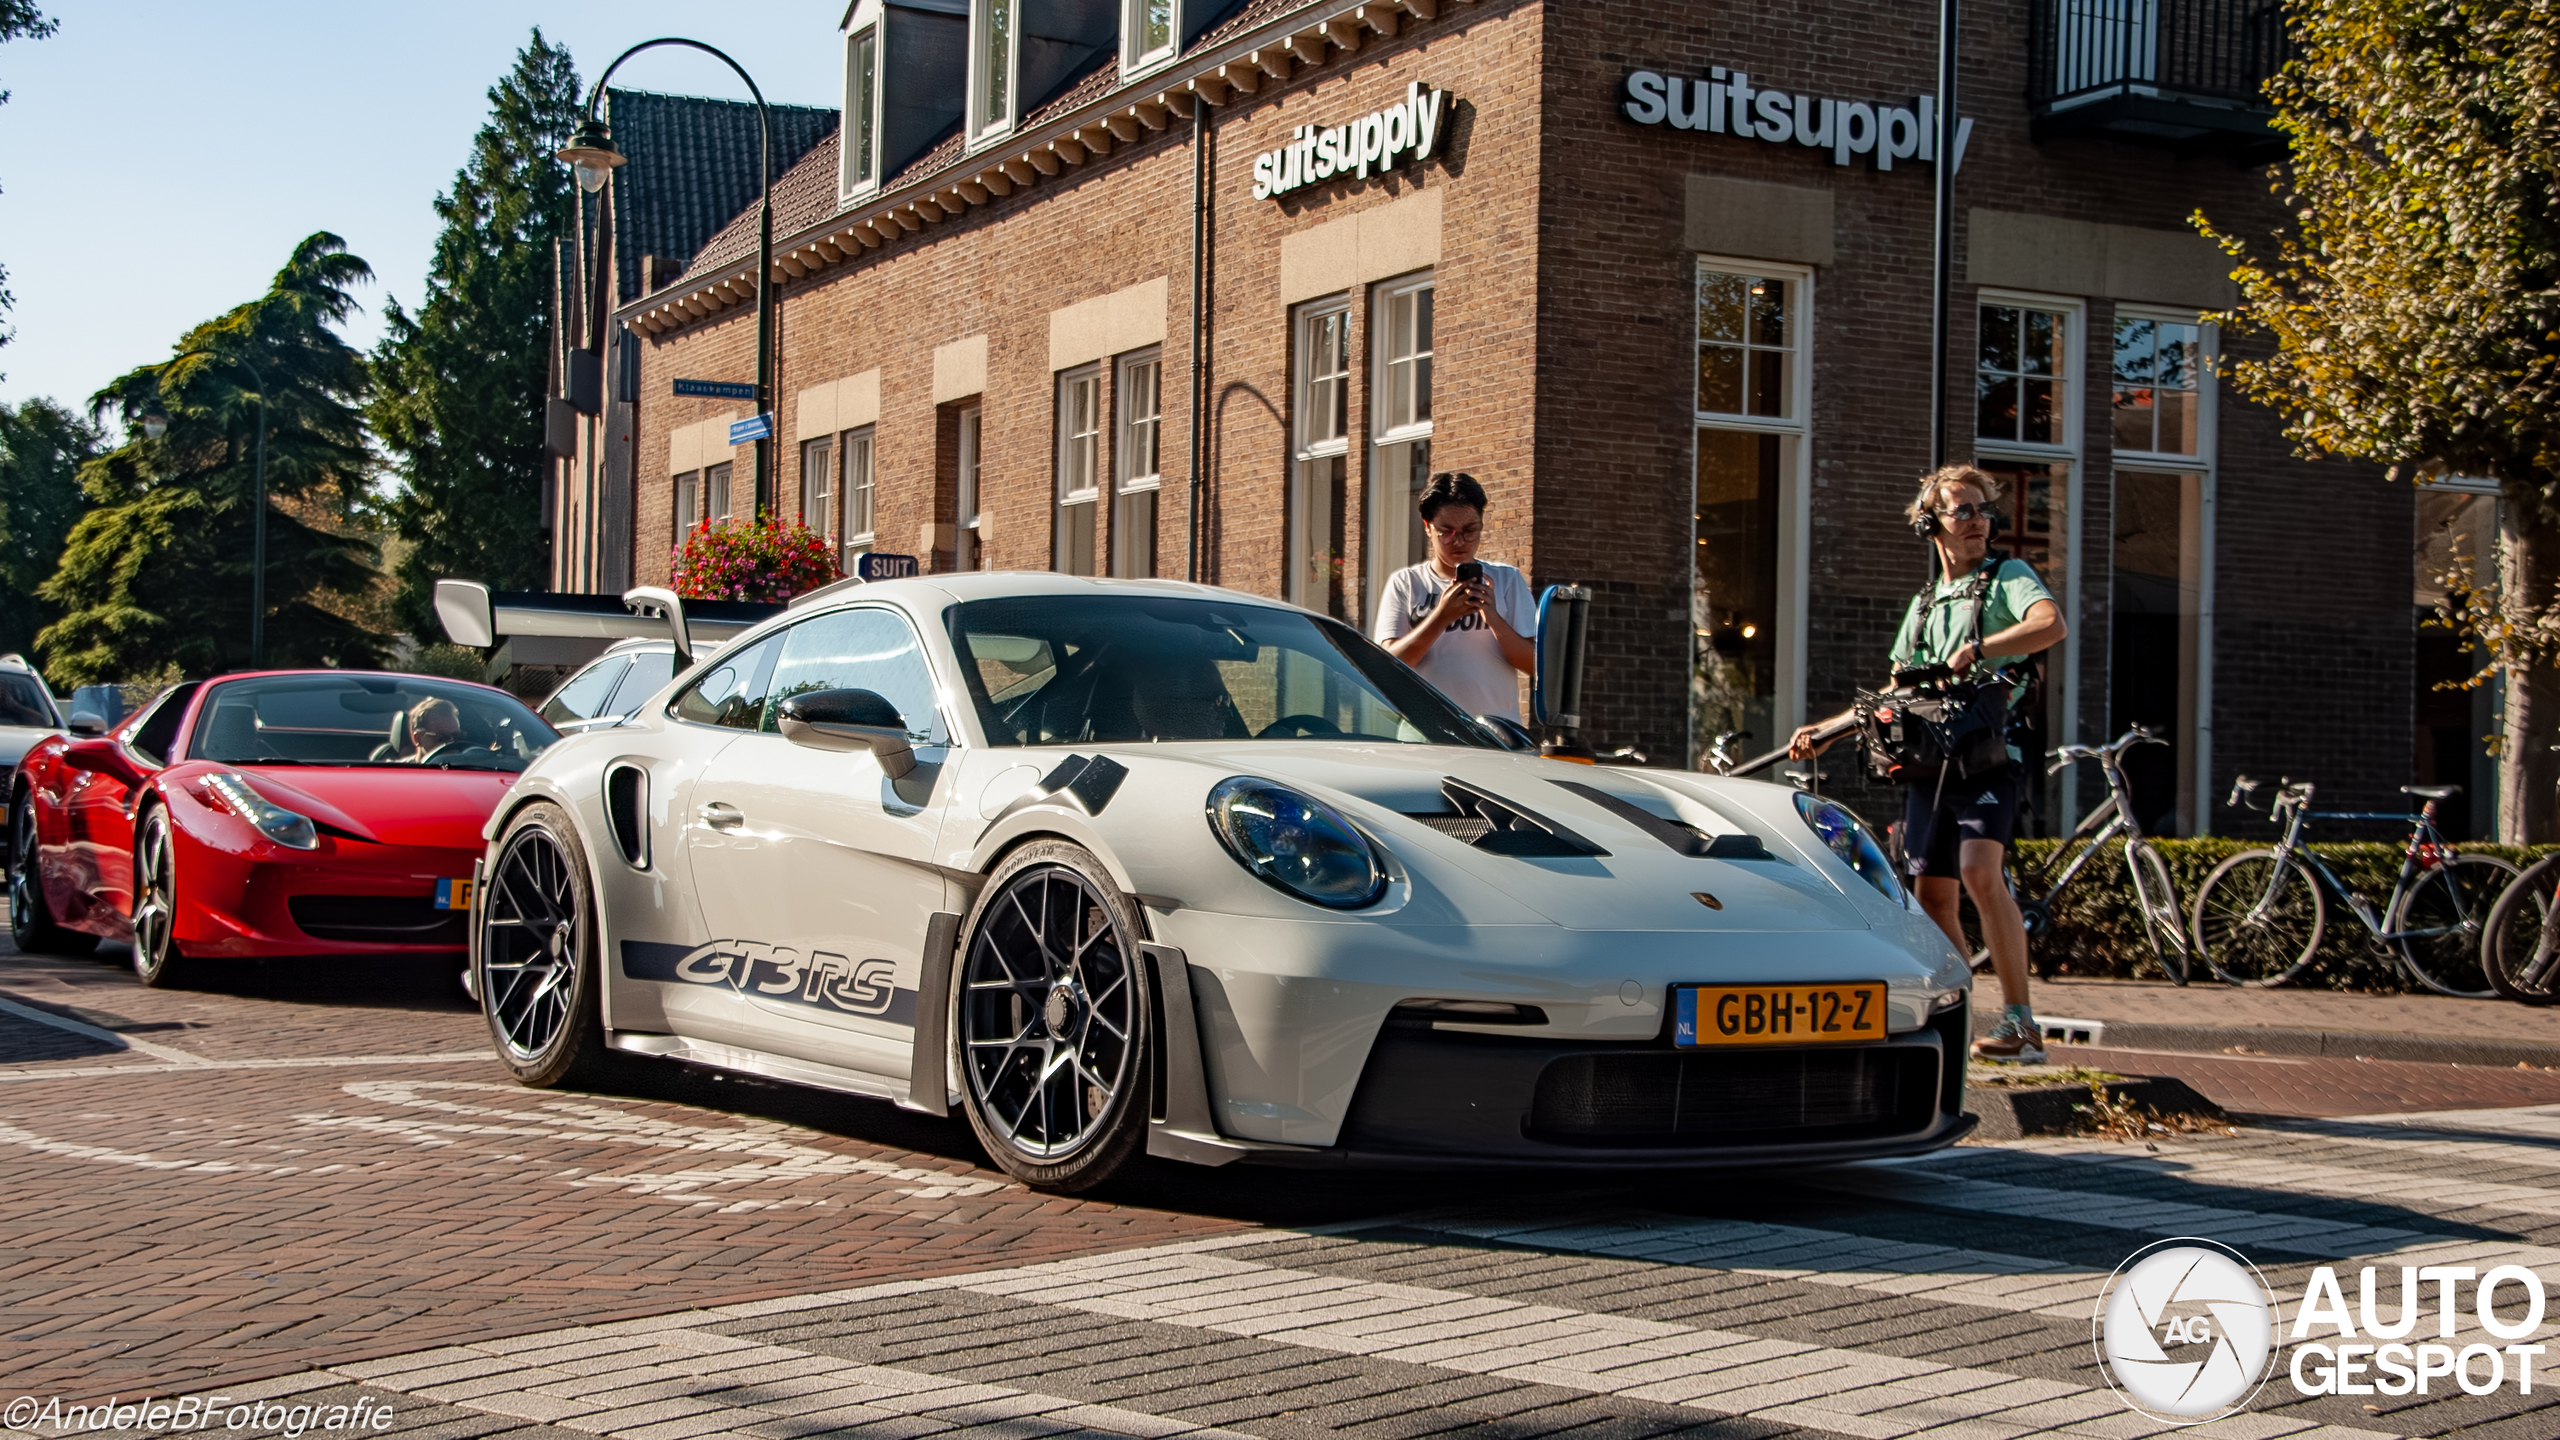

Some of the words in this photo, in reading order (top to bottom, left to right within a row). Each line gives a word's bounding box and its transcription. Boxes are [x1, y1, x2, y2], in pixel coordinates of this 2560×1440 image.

[1253, 81, 1442, 201] suitsupply
[871, 558, 910, 577] SUIT
[1678, 1022, 1693, 1036] NL
[1717, 991, 1872, 1036] GBH-12-Z
